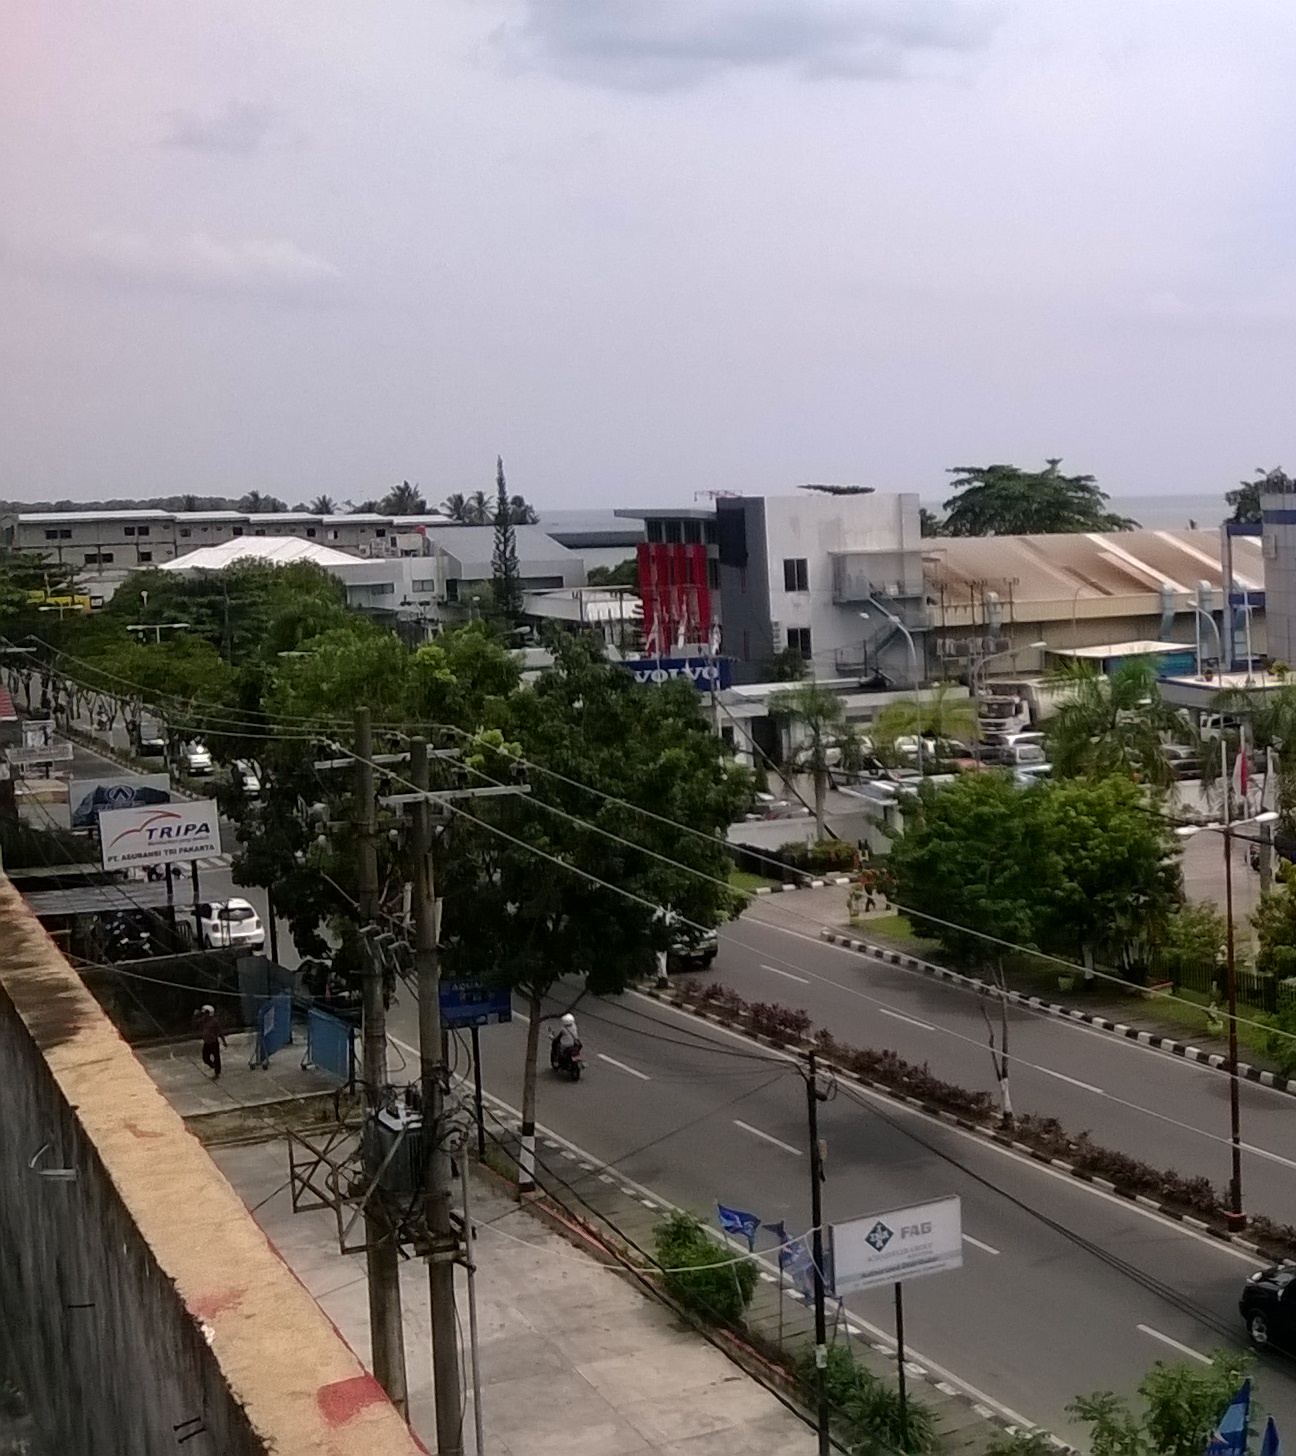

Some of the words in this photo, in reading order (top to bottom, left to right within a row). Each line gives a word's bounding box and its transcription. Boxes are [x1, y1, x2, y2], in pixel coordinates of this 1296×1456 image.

[634, 666, 719, 683] VOLVO
[145, 822, 211, 840] TRIPA
[163, 848, 178, 856] TRI
[900, 1221, 932, 1240] FAG
